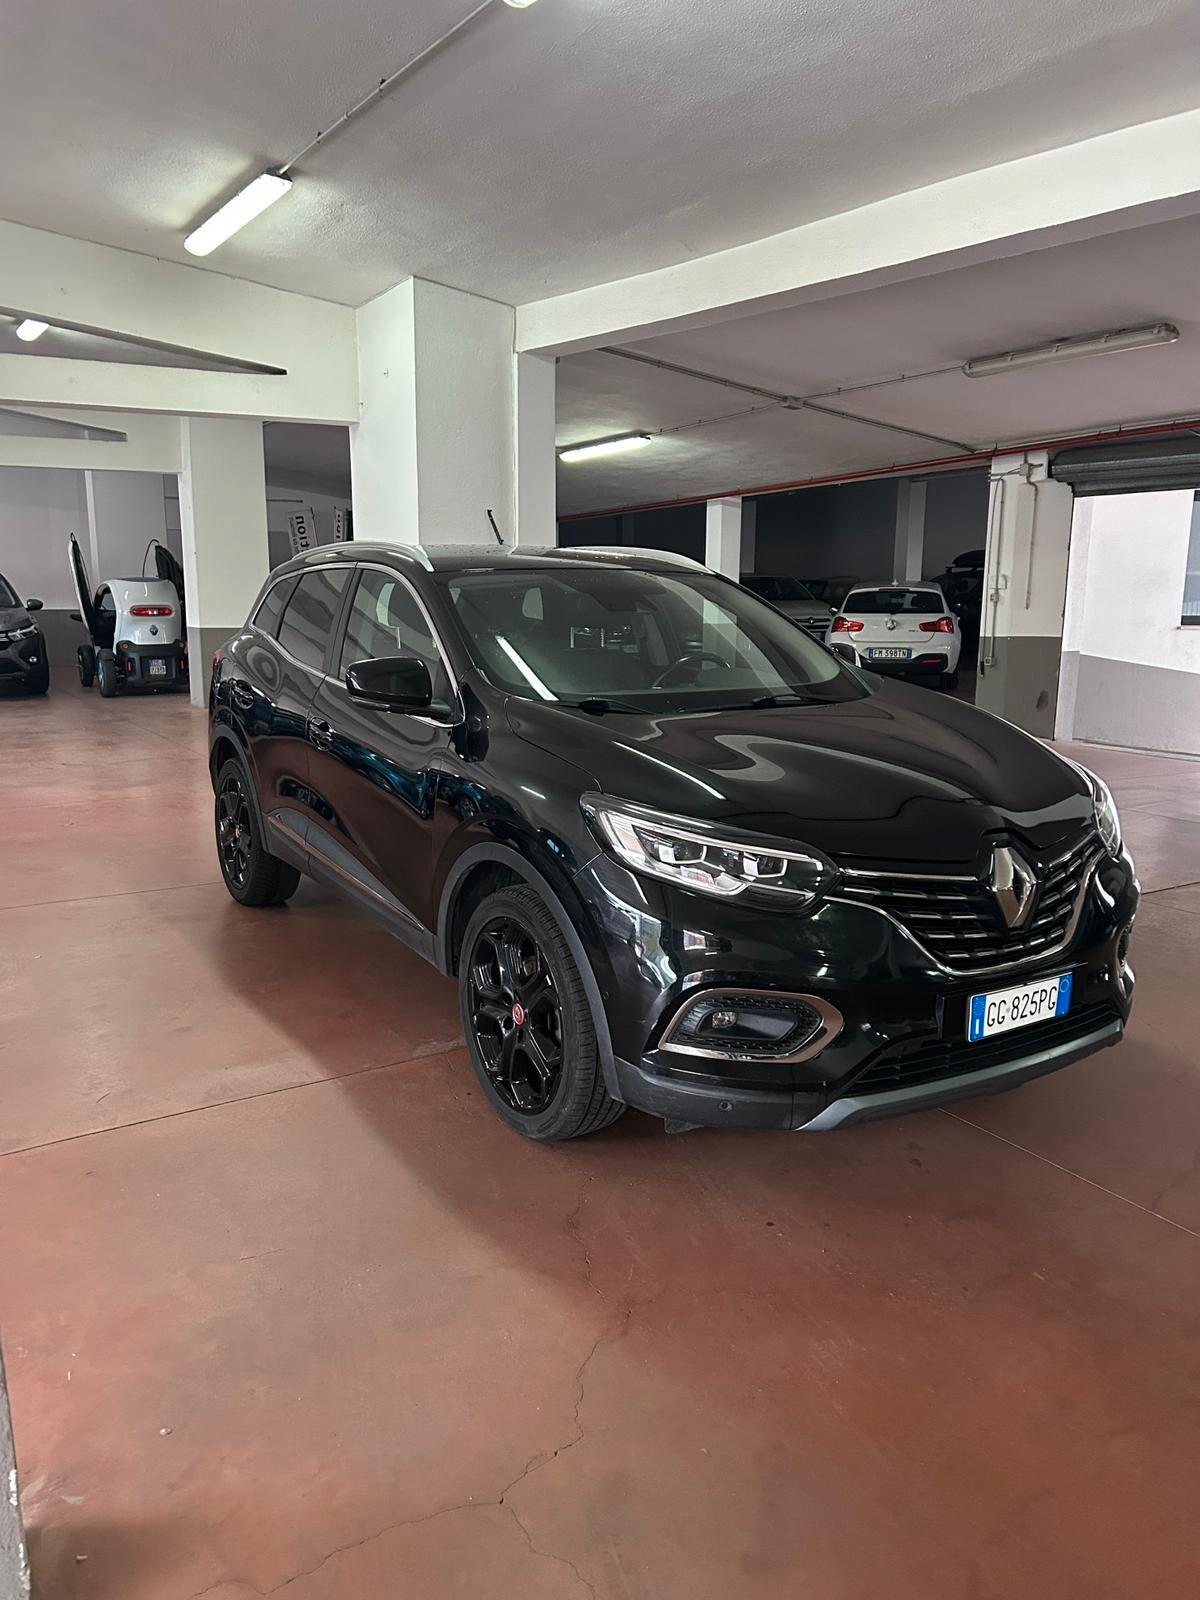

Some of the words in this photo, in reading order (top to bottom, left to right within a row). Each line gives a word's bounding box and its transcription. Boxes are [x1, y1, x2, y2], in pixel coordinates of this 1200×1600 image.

[873, 649, 883, 657] FM
[987, 1000, 1006, 1027] GG
[1011, 986, 1057, 1020] 825PG
